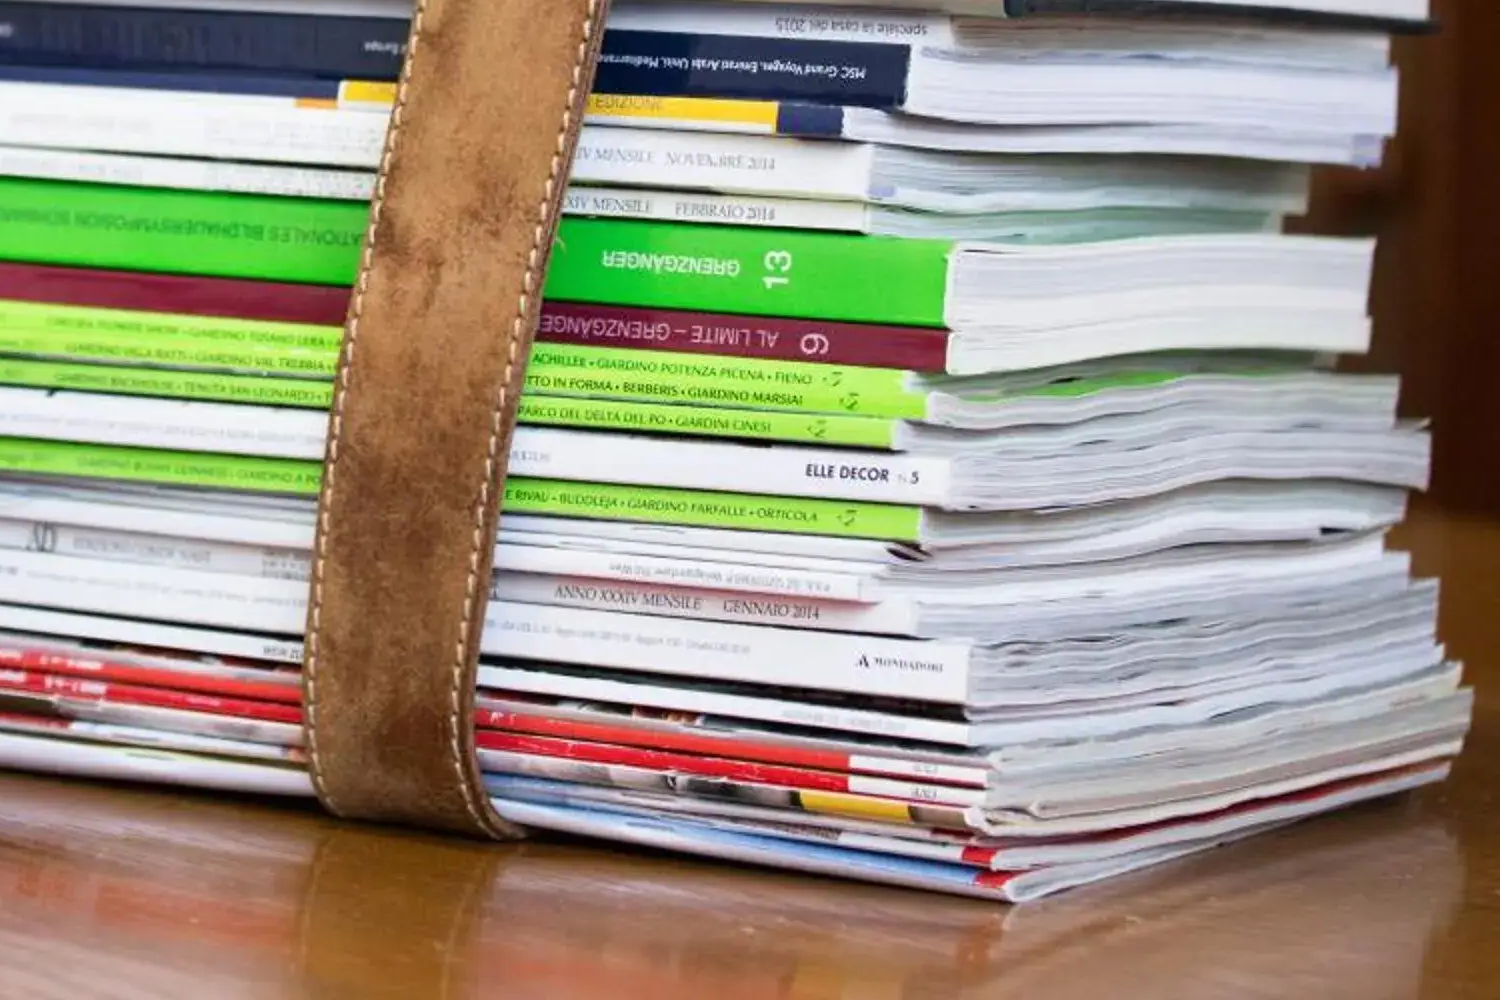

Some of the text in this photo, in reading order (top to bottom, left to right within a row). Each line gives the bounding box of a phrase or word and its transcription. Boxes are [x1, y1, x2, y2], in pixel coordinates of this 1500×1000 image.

[805, 63, 838, 78] Grand
[841, 64, 868, 79] MSC
[591, 197, 654, 215] MENSILE
[674, 200, 745, 219] FEBBRAIO
[601, 249, 741, 277] GRENZGÄNGER
[762, 250, 793, 291] 13
[534, 312, 671, 344] GRENZGÄNGE
[690, 324, 751, 346] LIMITE
[755, 329, 780, 347] AL
[595, 357, 659, 375] GIARDINO
[660, 361, 718, 378] POTENZA
[719, 365, 765, 382] PICENA
[774, 369, 813, 385] FIENO
[552, 376, 568, 391] IN
[568, 376, 613, 393] FORMA
[622, 381, 679, 398] BERBERIS
[686, 385, 750, 403] GIARDINO
[583, 408, 623, 424] DELTA
[624, 411, 647, 425] DEL
[674, 413, 730, 431] GIARDINI
[732, 417, 772, 433] CINESI
[805, 463, 835, 480] ELLE
[839, 465, 890, 483] DECOR
[626, 496, 689, 514] GIARDINO
[690, 501, 747, 518] FARFALLE
[756, 506, 819, 523] ORTICOLA
[553, 584, 821, 621] ANNO XXXIV MENSILE GENNAIO 2014
